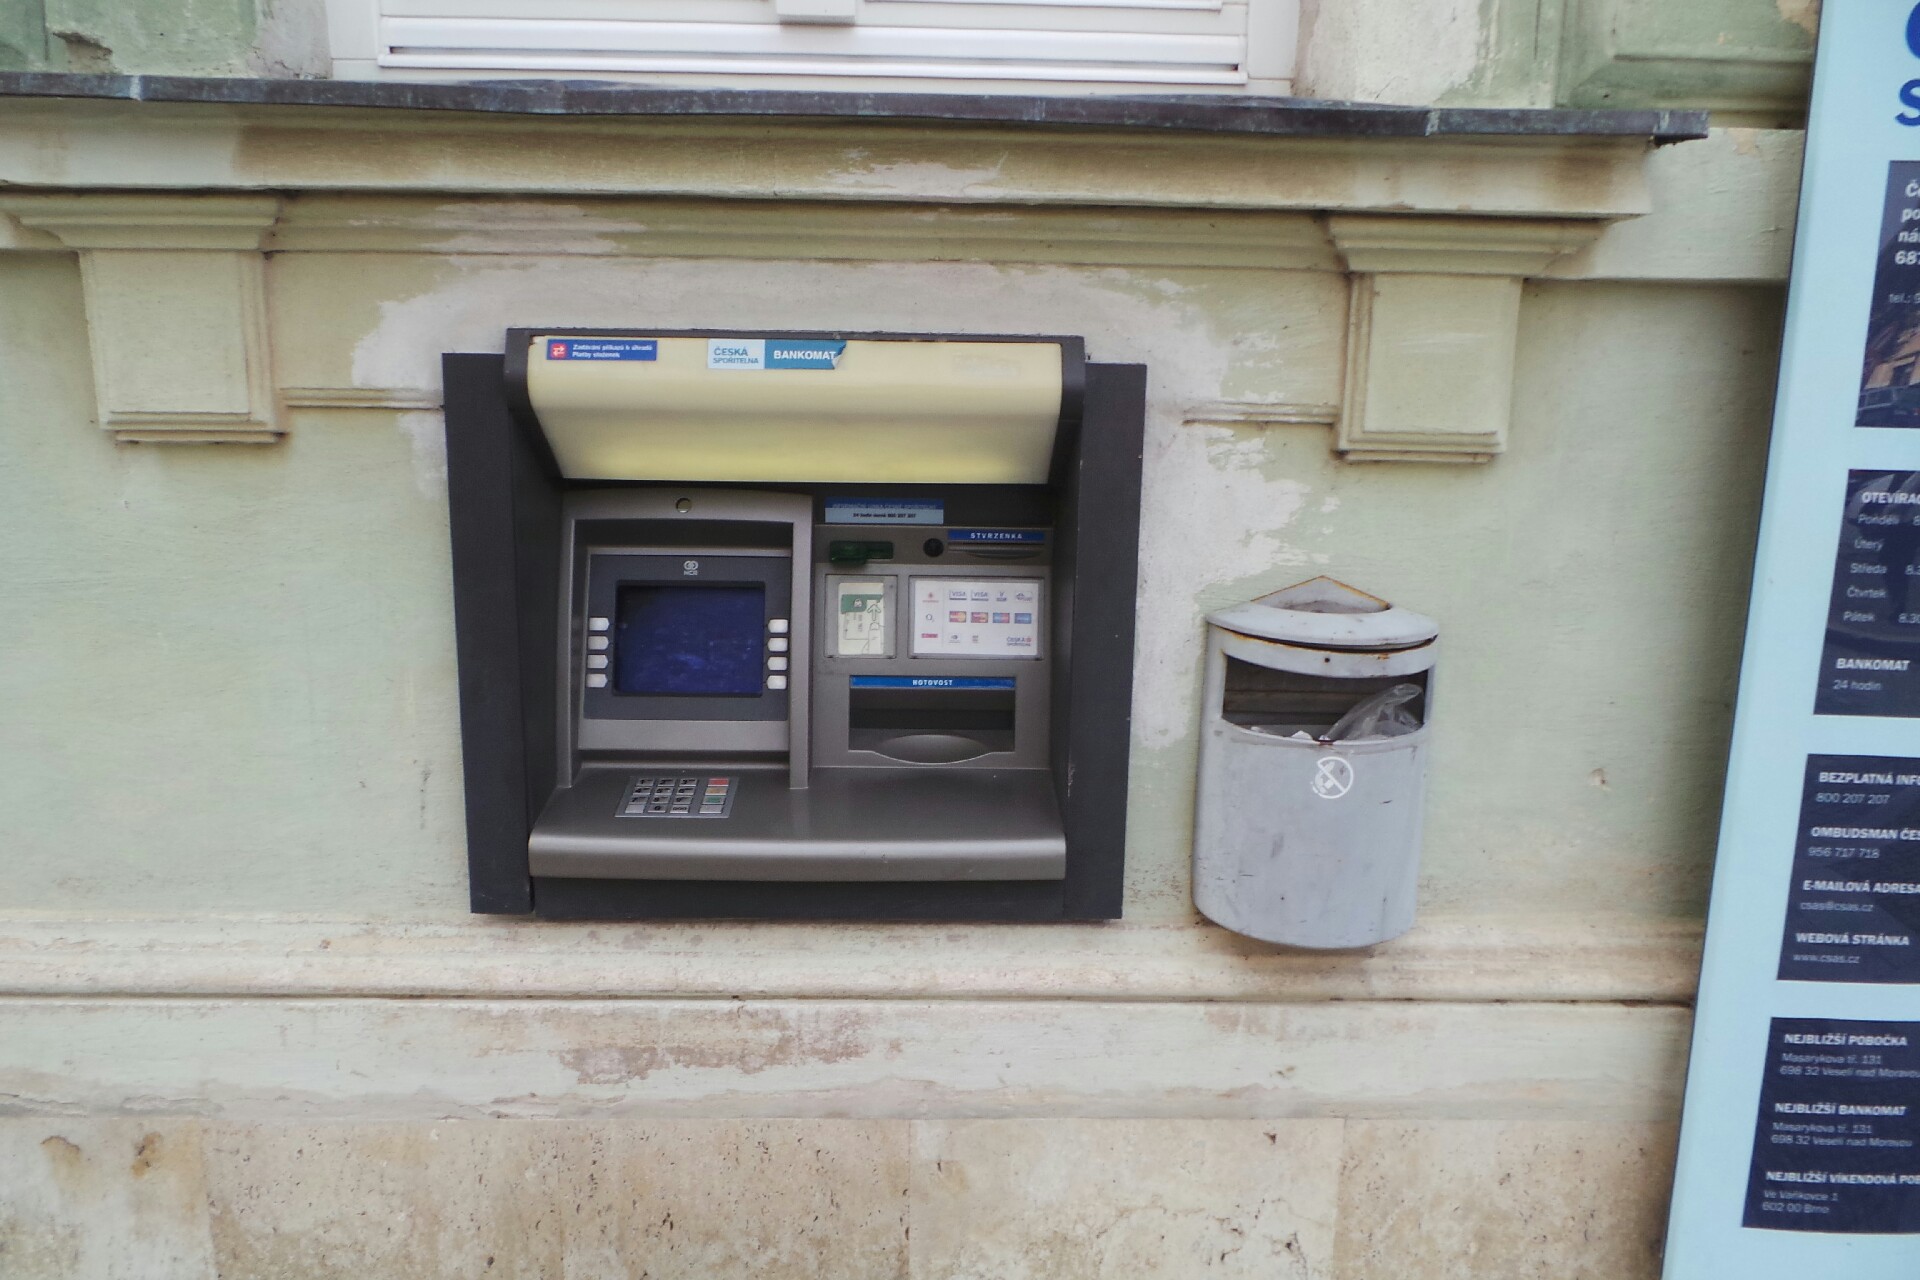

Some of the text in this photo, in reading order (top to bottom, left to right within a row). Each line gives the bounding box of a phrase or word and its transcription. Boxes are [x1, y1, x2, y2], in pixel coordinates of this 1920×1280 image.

[714, 346, 748, 356] ČESKÁ
[773, 350, 836, 360] BANKOMAT
[1836, 658, 1910, 671] BANKOMAT
[1833, 680, 1848, 690] 24
[1819, 772, 1893, 785] BEZPLATNÁ
[1816, 792, 1890, 804] 800 207 207
[1811, 827, 1898, 839] OMBUDSMAN
[1808, 847, 1880, 859] 956 717 718
[1803, 880, 1870, 892] E-MAILOVÁ
[1796, 932, 1910, 946] WEBOVÁ STRÁNKA
[1784, 1033, 1907, 1046] NEJBLIŽŠÍ POBOČKA
[1775, 1102, 1907, 1116] NEJBLIŽŠÍ BANKOMAT
[1766, 1170, 1827, 1182] NEJBLIŽŠÍ
[1829, 1172, 1896, 1184] VÍKENDOVÁ
